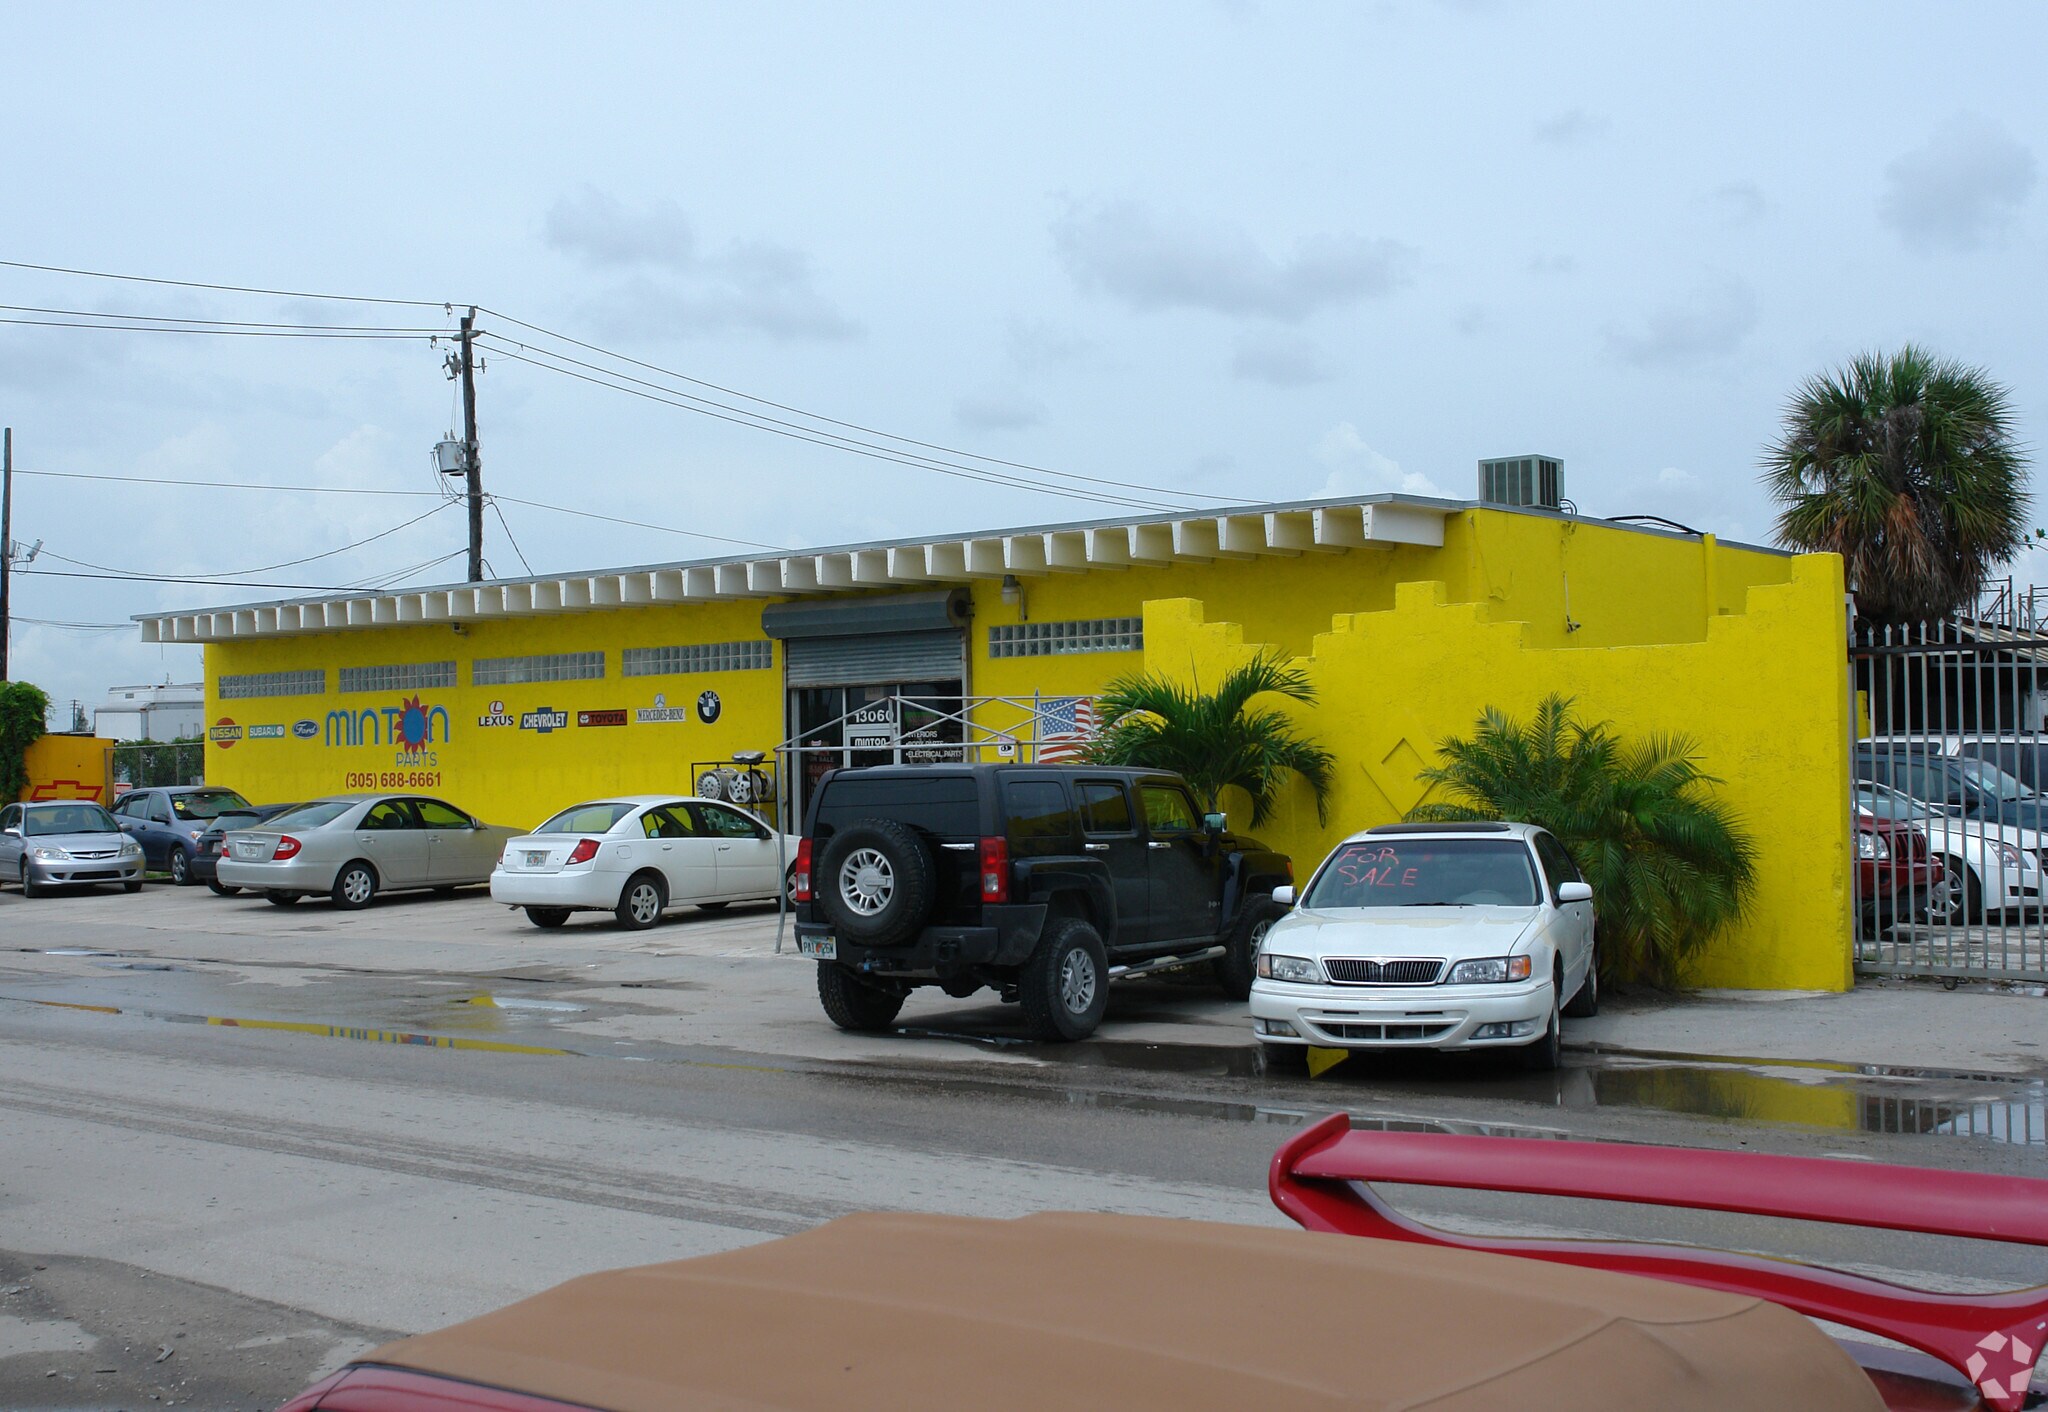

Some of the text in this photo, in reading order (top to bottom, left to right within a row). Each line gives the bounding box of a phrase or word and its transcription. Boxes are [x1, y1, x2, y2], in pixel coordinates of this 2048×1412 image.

[478, 715, 514, 727] LEXUS
[523, 713, 566, 728] CHEVROLET
[589, 713, 625, 724] TOYOTA
[637, 708, 684, 721] MERCEDES-BENZ
[295, 723, 317, 735] Ford
[326, 704, 449, 747] MINTON
[210, 728, 242, 739] NISSAN
[249, 727, 278, 738] SUBARU
[854, 737, 886, 747] MINTON
[396, 752, 438, 767] PARTS
[345, 772, 441, 788] (305) 688-6661
[1338, 847, 1399, 865] FOR
[1338, 865, 1418, 886] SALE
